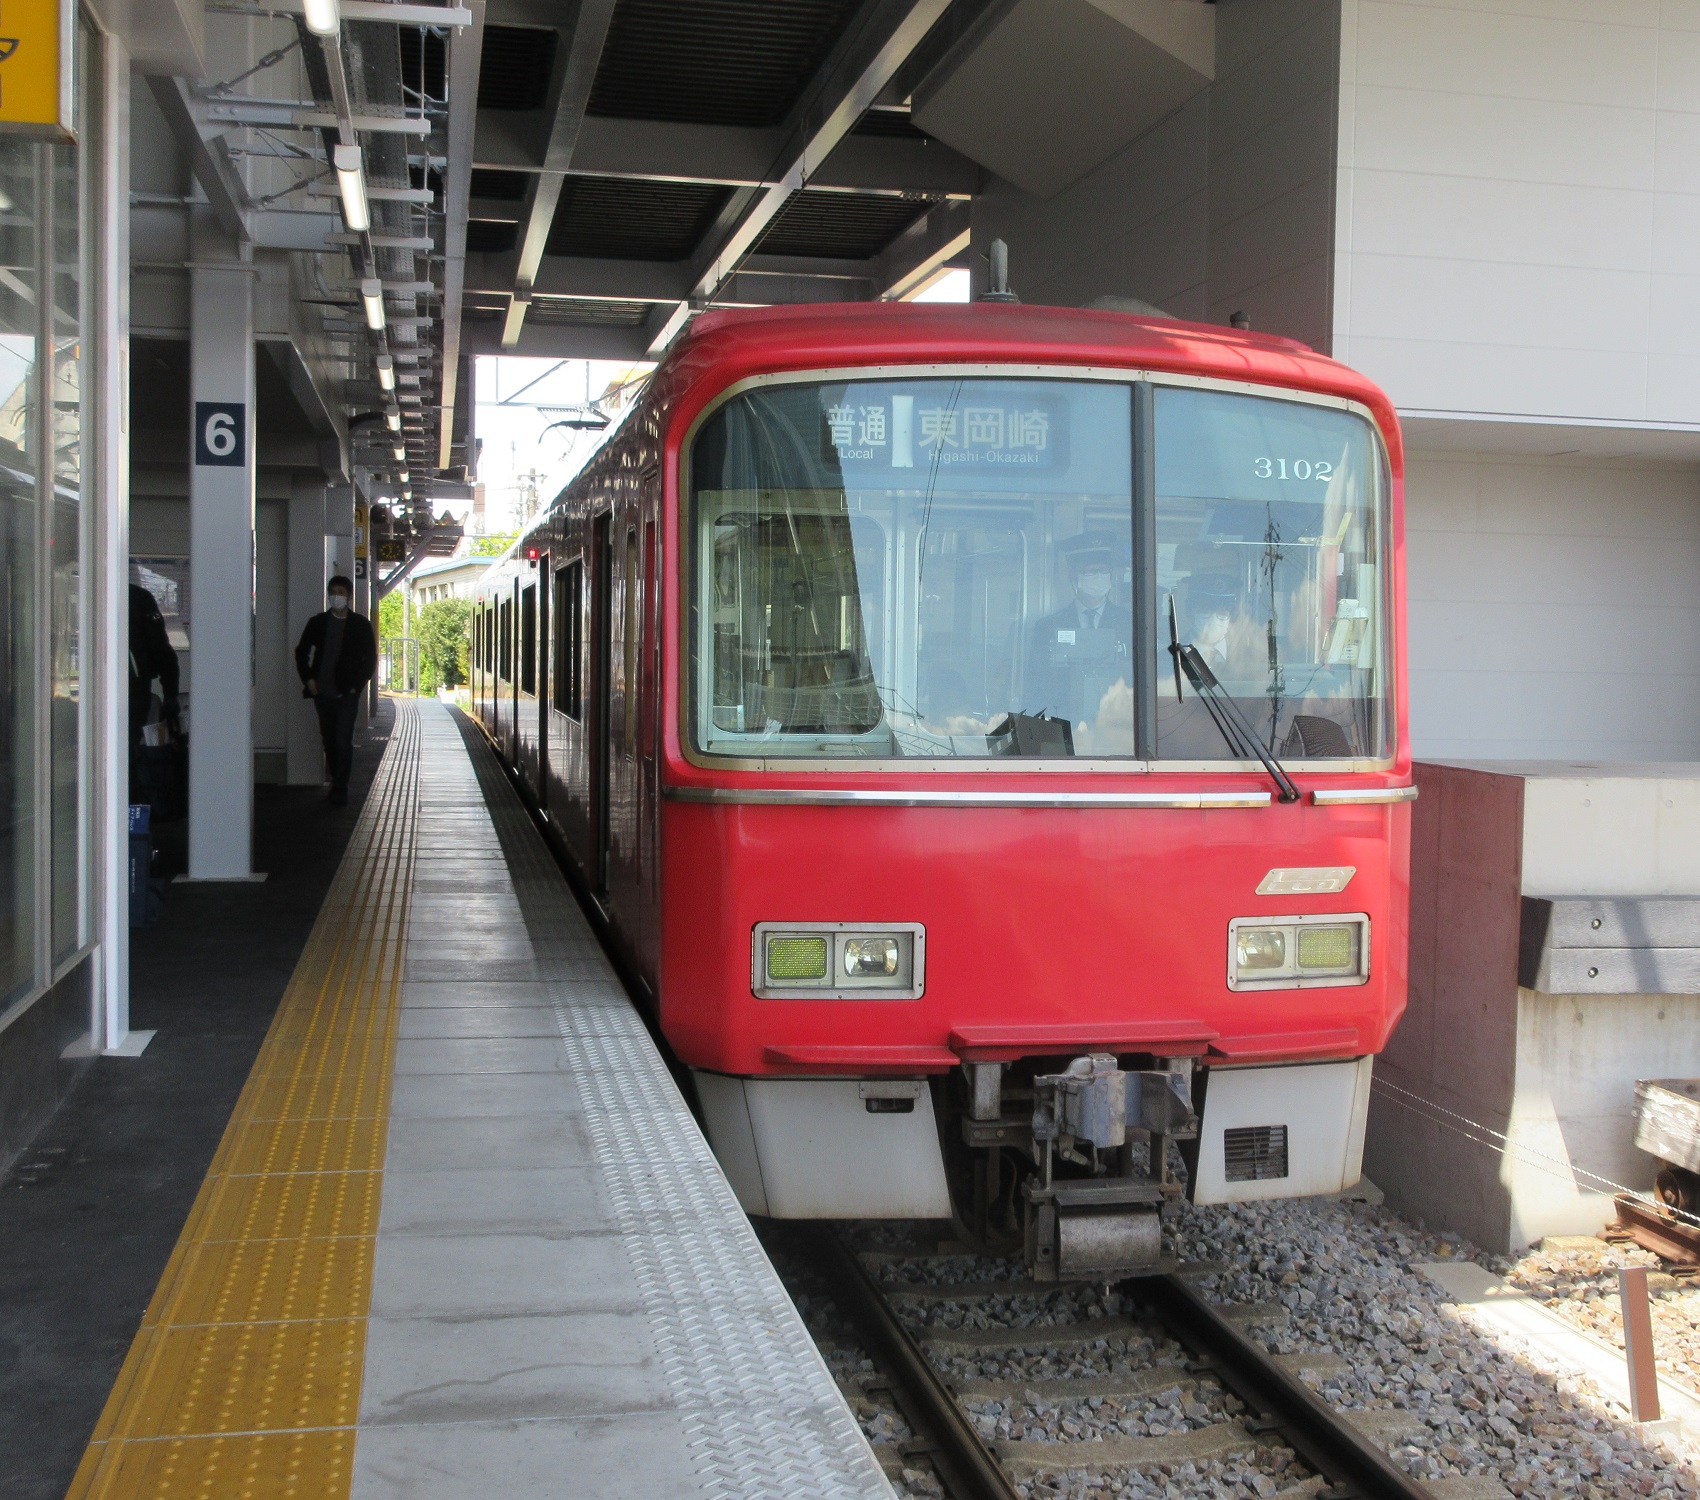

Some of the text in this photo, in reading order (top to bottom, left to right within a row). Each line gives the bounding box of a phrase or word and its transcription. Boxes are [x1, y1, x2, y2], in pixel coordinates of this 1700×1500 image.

[205, 412, 236, 457] 6
[828, 404, 1049, 450] 普通 東岡崎
[840, 447, 873, 459] Local
[1254, 457, 1332, 482] 3102
